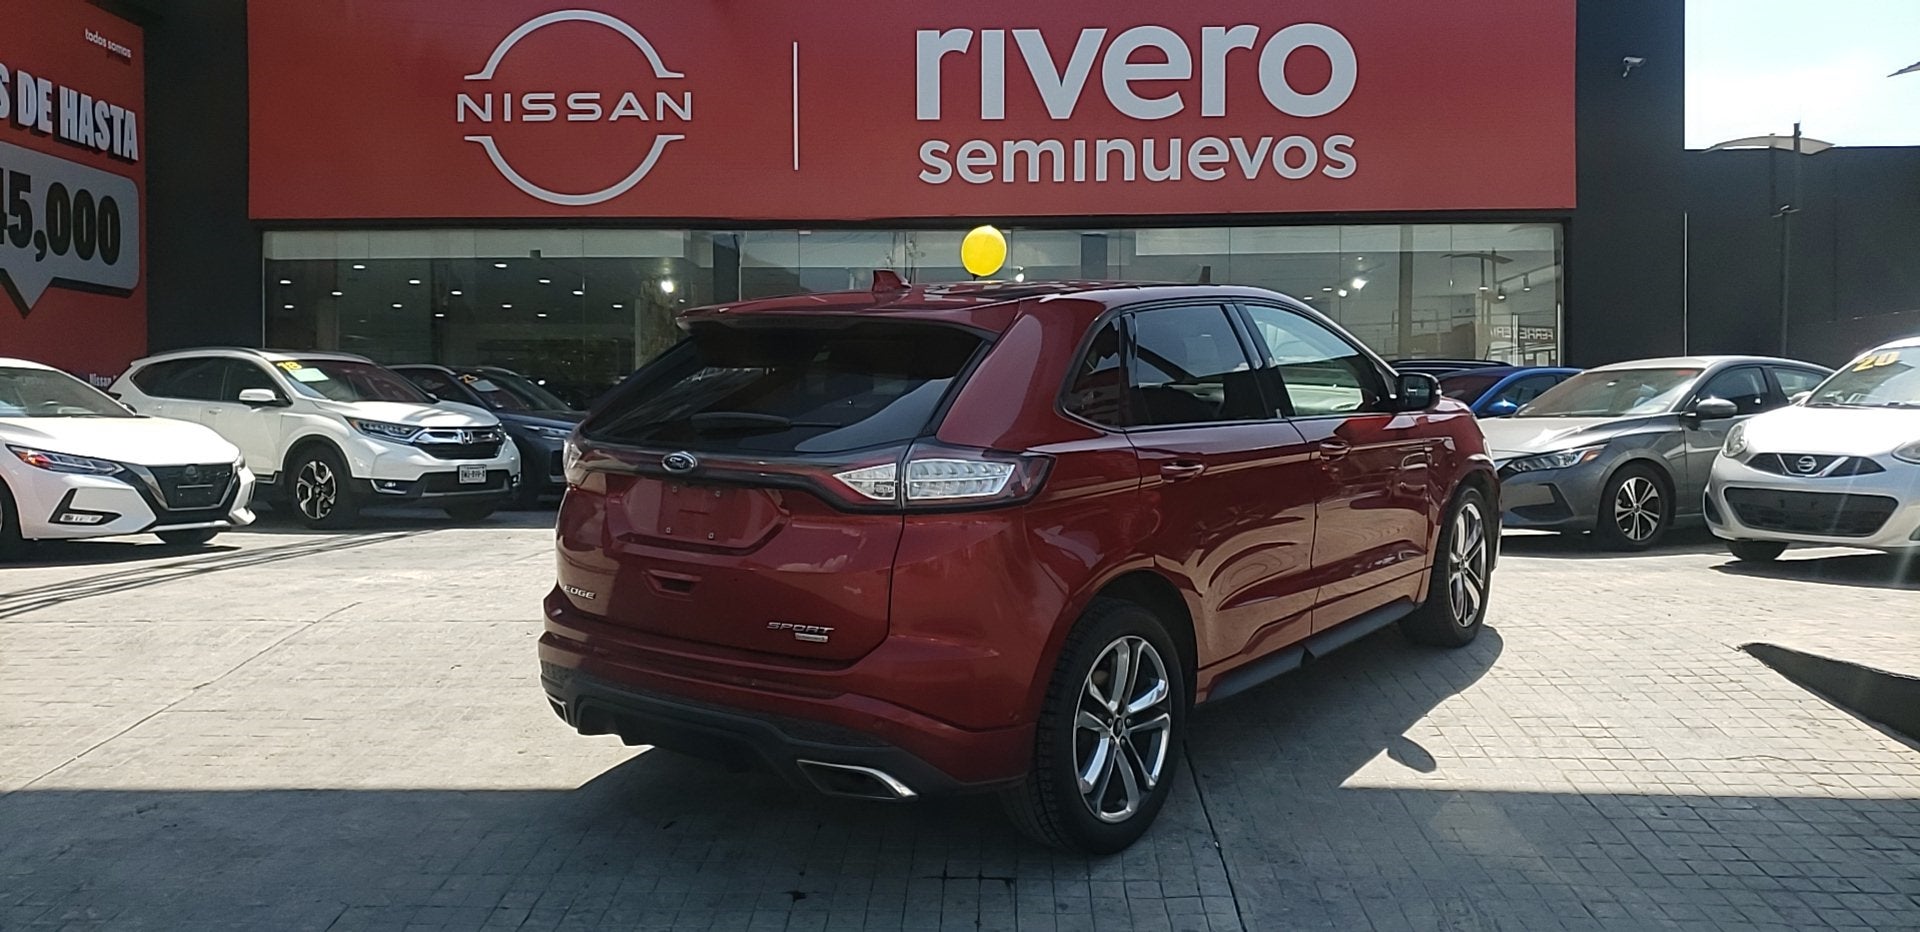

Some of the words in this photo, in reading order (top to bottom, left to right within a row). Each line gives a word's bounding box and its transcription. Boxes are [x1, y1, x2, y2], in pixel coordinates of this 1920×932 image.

[84, 28, 107, 48] todos
[107, 40, 132, 59] somos
[916, 23, 1358, 120] rivero
[17, 69, 53, 134] DE
[59, 85, 139, 161] HASTA
[457, 91, 692, 122] NISSAN
[918, 134, 1358, 184] seminuevos
[1851, 351, 1901, 372] 20
[563, 585, 596, 600] EDGE
[766, 621, 835, 635] SPORT
